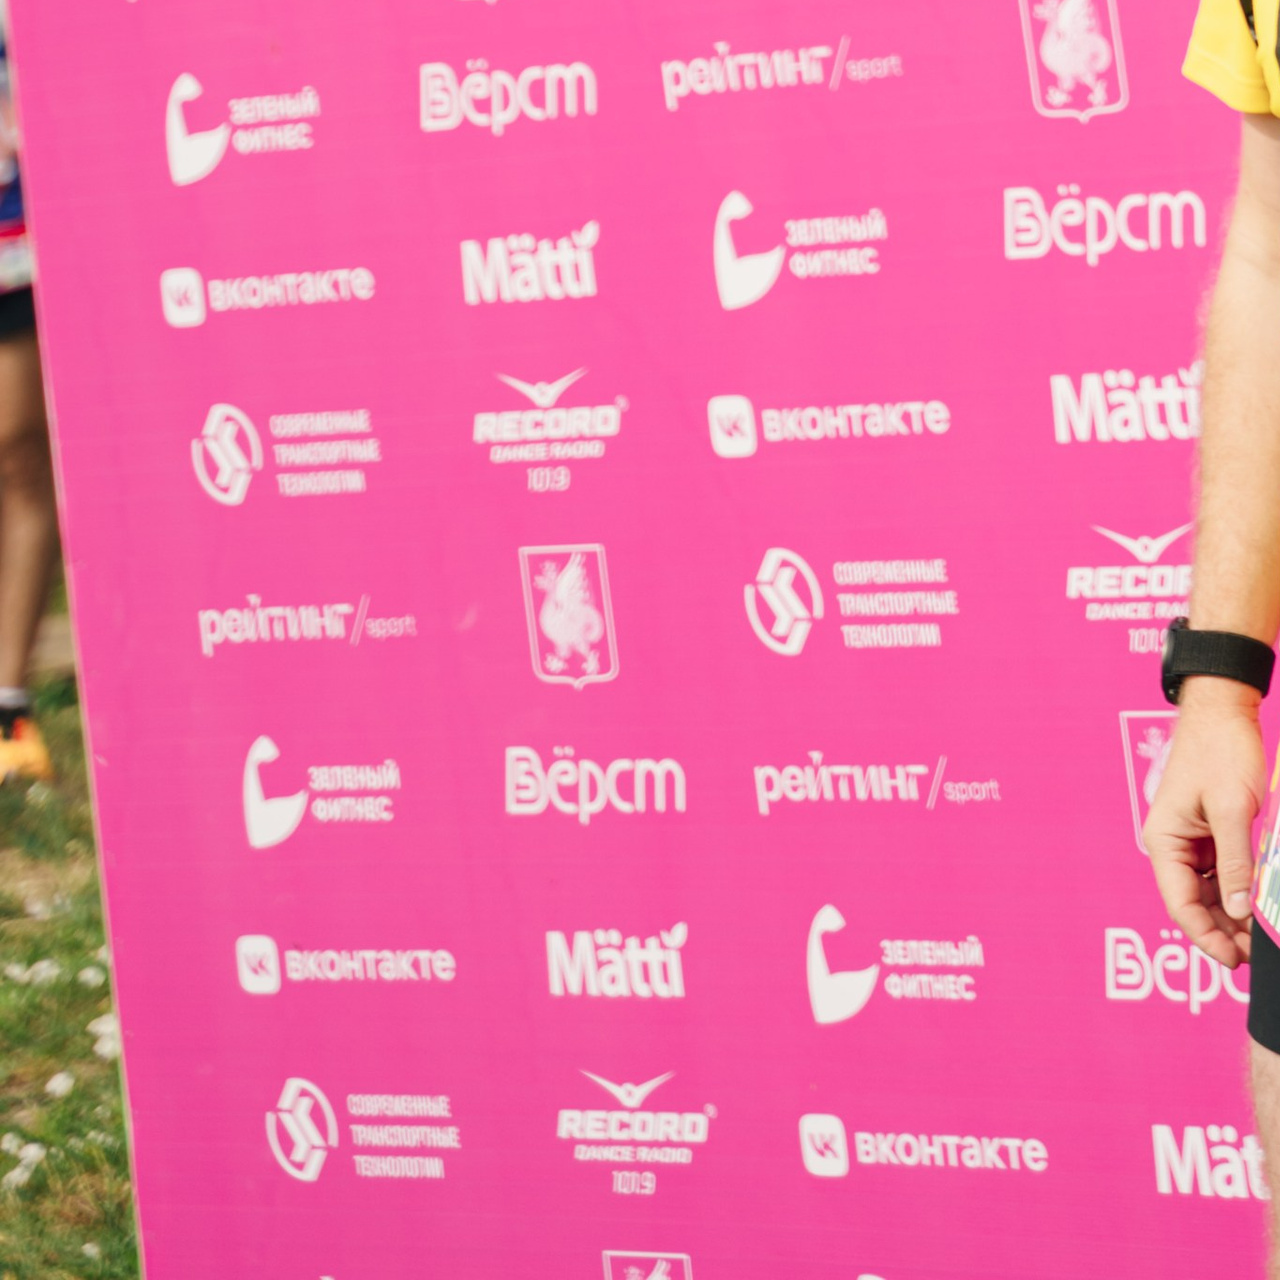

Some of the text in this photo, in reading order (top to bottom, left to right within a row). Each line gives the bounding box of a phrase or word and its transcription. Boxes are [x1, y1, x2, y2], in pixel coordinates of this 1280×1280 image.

[461, 222, 600, 306] Mätti
[790, 248, 881, 279] ФИТНЕС
[474, 406, 621, 444] RECORD
[1087, 603, 1155, 621] DANCE
[547, 923, 689, 999] Mätti
[881, 936, 985, 967] ЗЕЛЕНЫЙ
[885, 974, 977, 1001] ФИТНЕС
[558, 1111, 711, 1144] RECORD
[575, 1146, 693, 1164] DANCE RADIO
